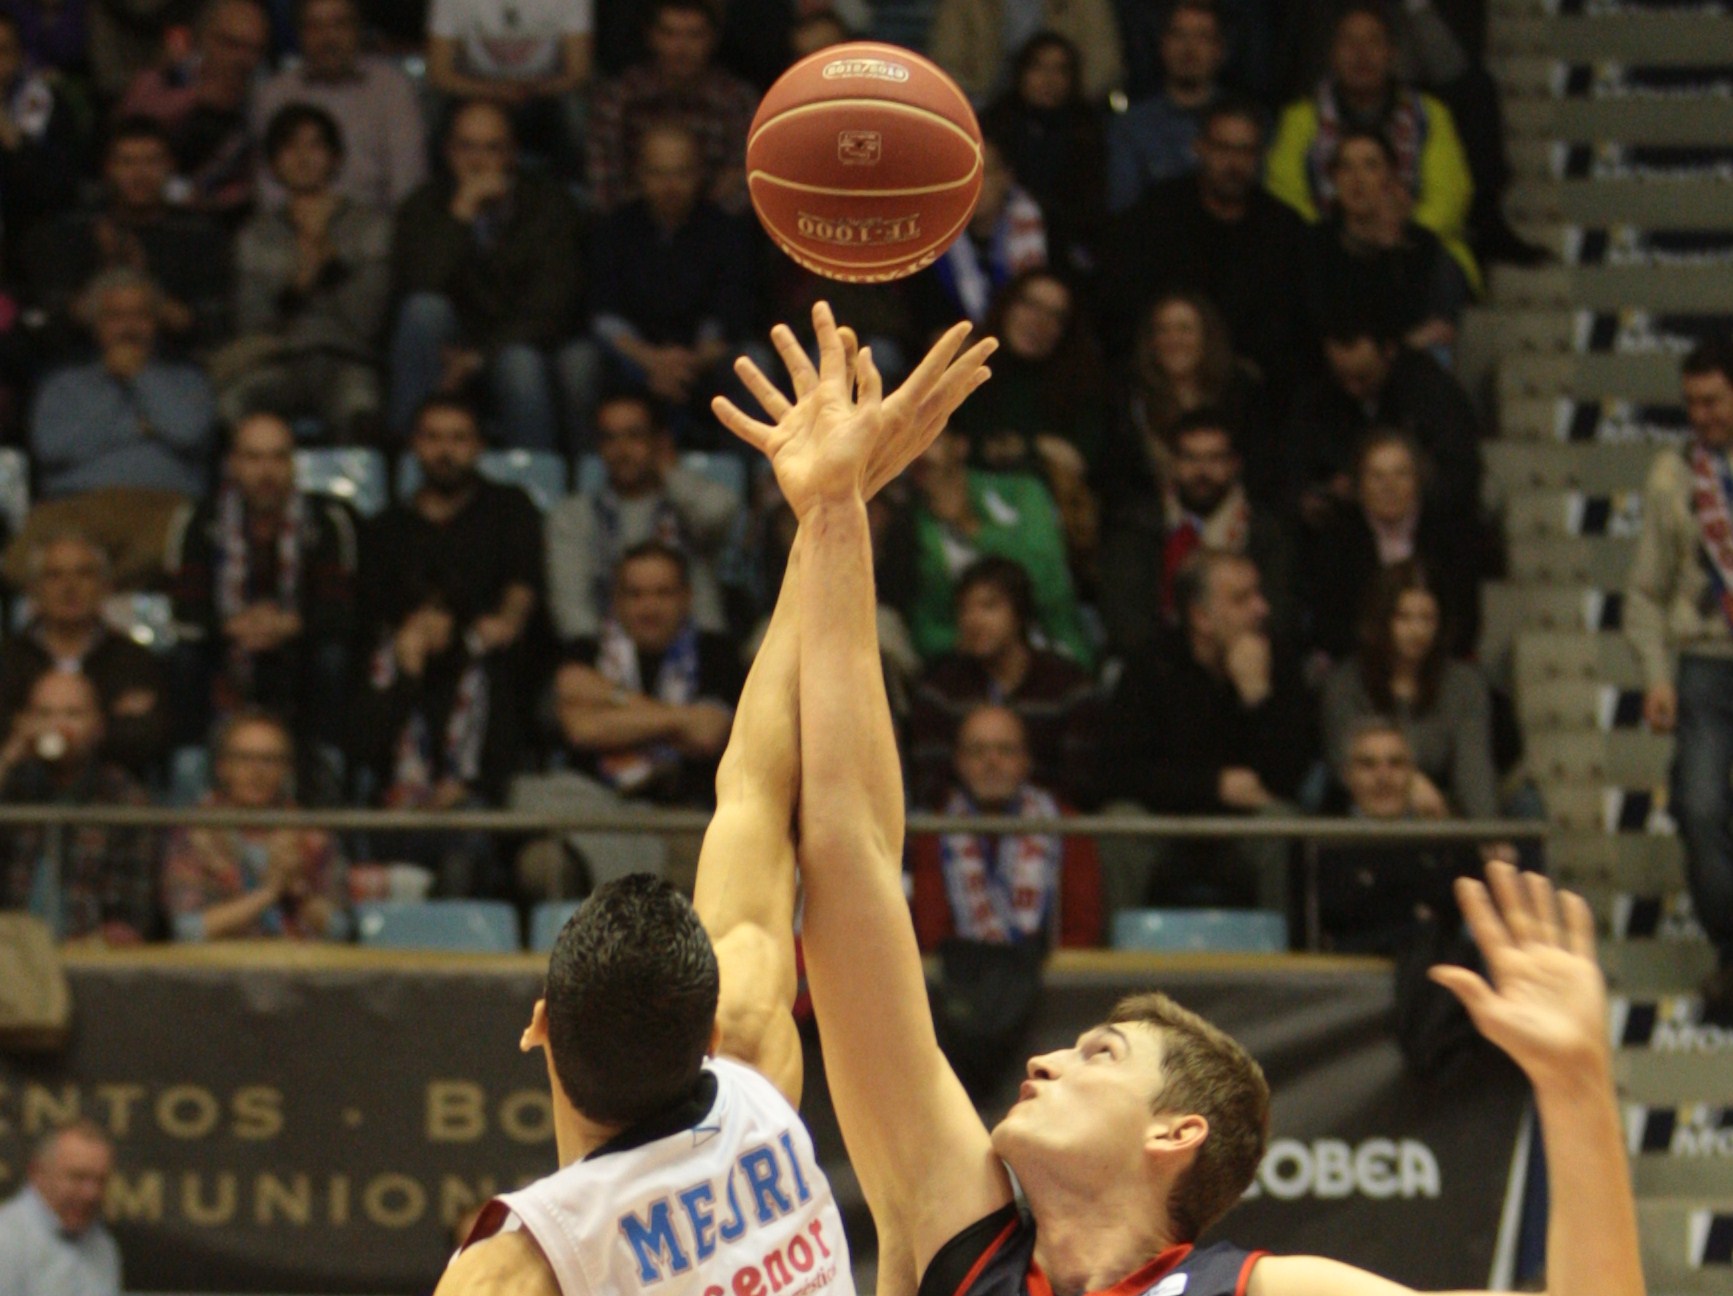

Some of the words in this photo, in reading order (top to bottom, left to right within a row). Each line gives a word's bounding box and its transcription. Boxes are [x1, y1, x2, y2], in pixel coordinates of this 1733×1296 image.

[0, 1083, 286, 1140] NTOS
[427, 1079, 555, 1144] BO
[1241, 1137, 1441, 1199] OBEA
[619, 1130, 812, 1287] MEJRI
